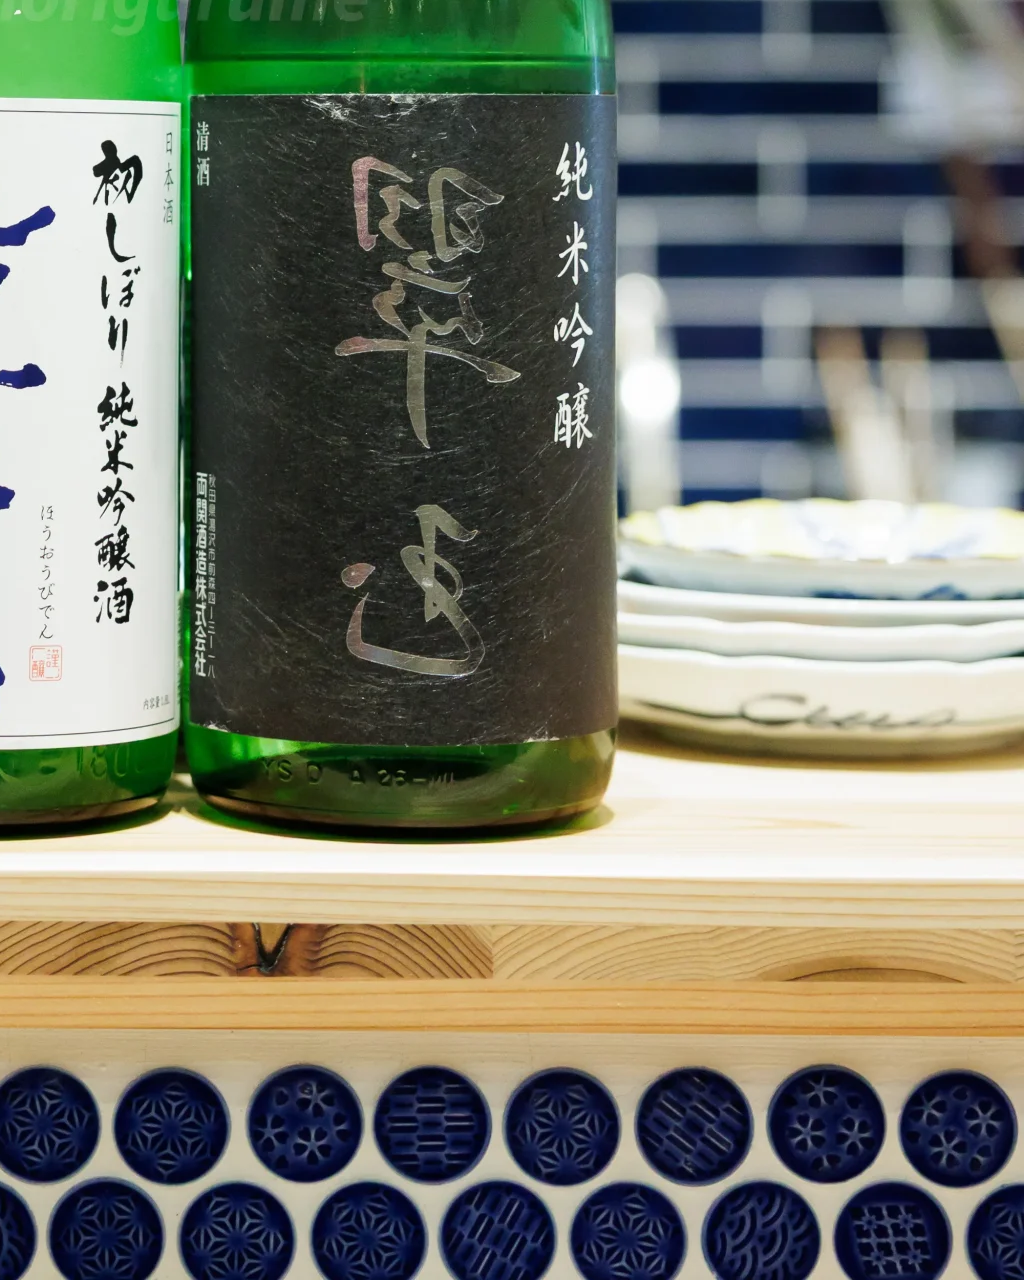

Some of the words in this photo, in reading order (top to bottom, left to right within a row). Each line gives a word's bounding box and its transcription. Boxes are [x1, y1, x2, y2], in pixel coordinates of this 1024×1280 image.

[163, 131, 174, 225] 日本酒
[196, 121, 210, 186] 清酒
[553, 141, 594, 450] 純米吟醸
[37, 505, 55, 639] ほうおうびでん
[195, 471, 207, 678] 両関酒造株式会社
